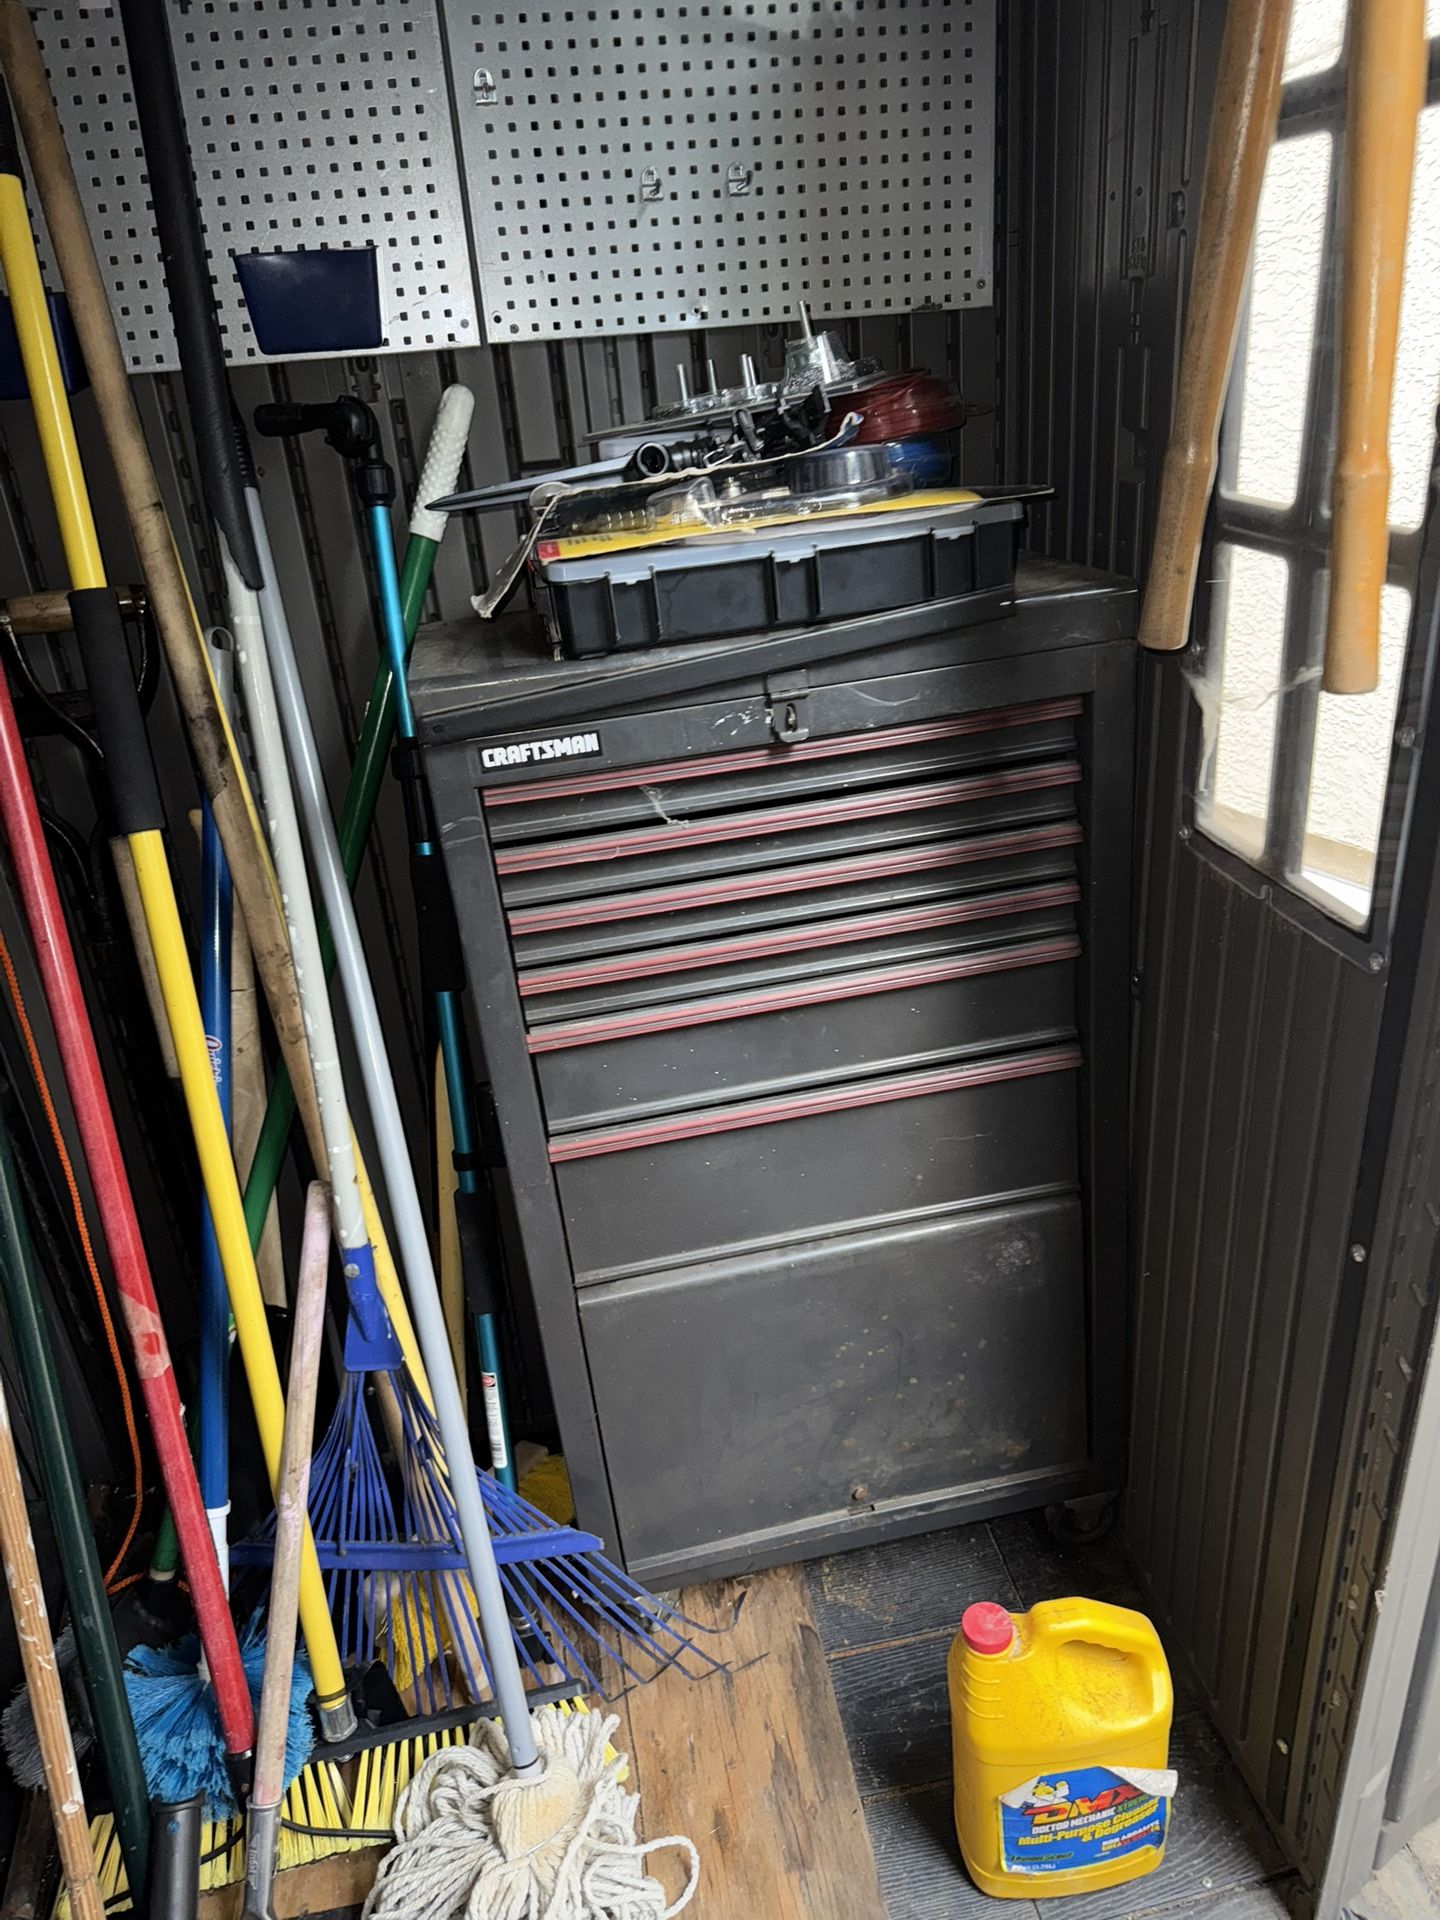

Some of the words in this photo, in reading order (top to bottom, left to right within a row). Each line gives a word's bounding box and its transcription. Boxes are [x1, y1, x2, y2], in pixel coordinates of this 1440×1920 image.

[481, 733, 600, 768] CRAFTSMAN
[1018, 1819, 1112, 1845] Multi-Purpose
[1031, 1821, 1070, 1835] DOCTOR
[1070, 1807, 1117, 1828] MECHANIC
[1081, 1831, 1092, 1842] &
